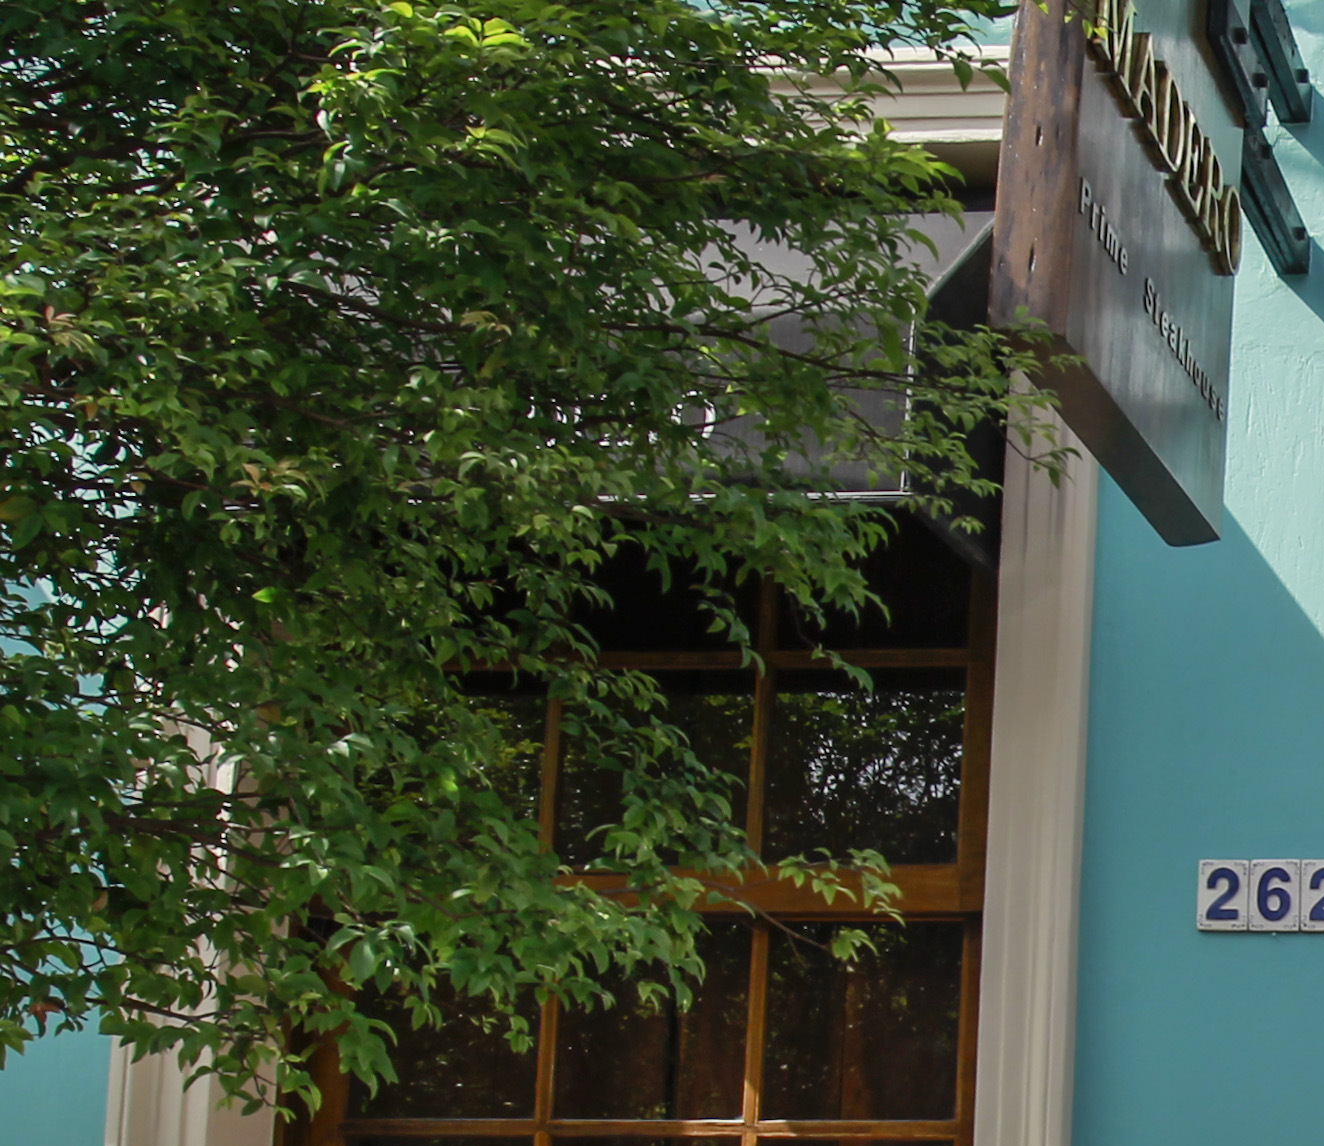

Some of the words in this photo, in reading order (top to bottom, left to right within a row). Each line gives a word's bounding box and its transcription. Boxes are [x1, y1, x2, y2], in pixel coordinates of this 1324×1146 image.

[1094, 0, 1242, 275] MADERO
[1079, 177, 1128, 275] Prime
[1142, 277, 1225, 422] Steakhouse
